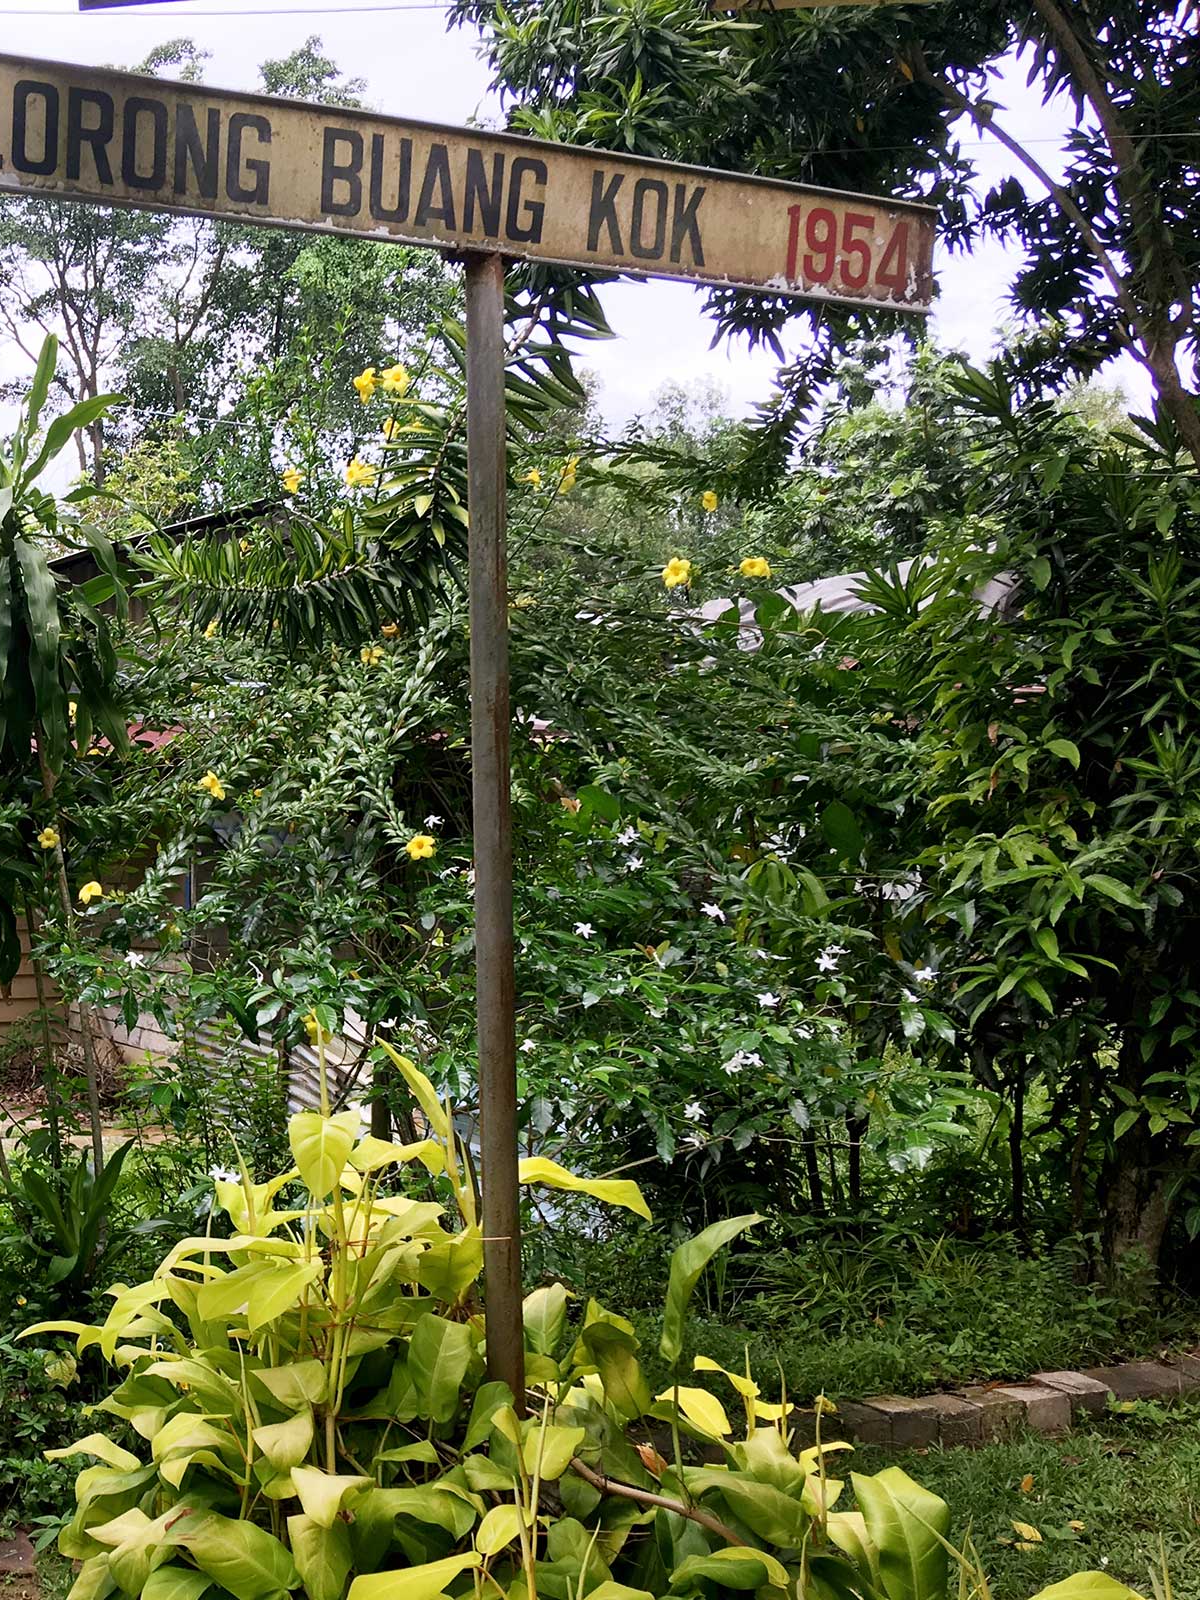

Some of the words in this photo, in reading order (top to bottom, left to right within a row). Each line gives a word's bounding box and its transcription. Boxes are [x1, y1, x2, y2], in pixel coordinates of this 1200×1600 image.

[321, 127, 548, 244] BUANG
[587, 169, 707, 267] KOK
[786, 204, 911, 300] 1954
